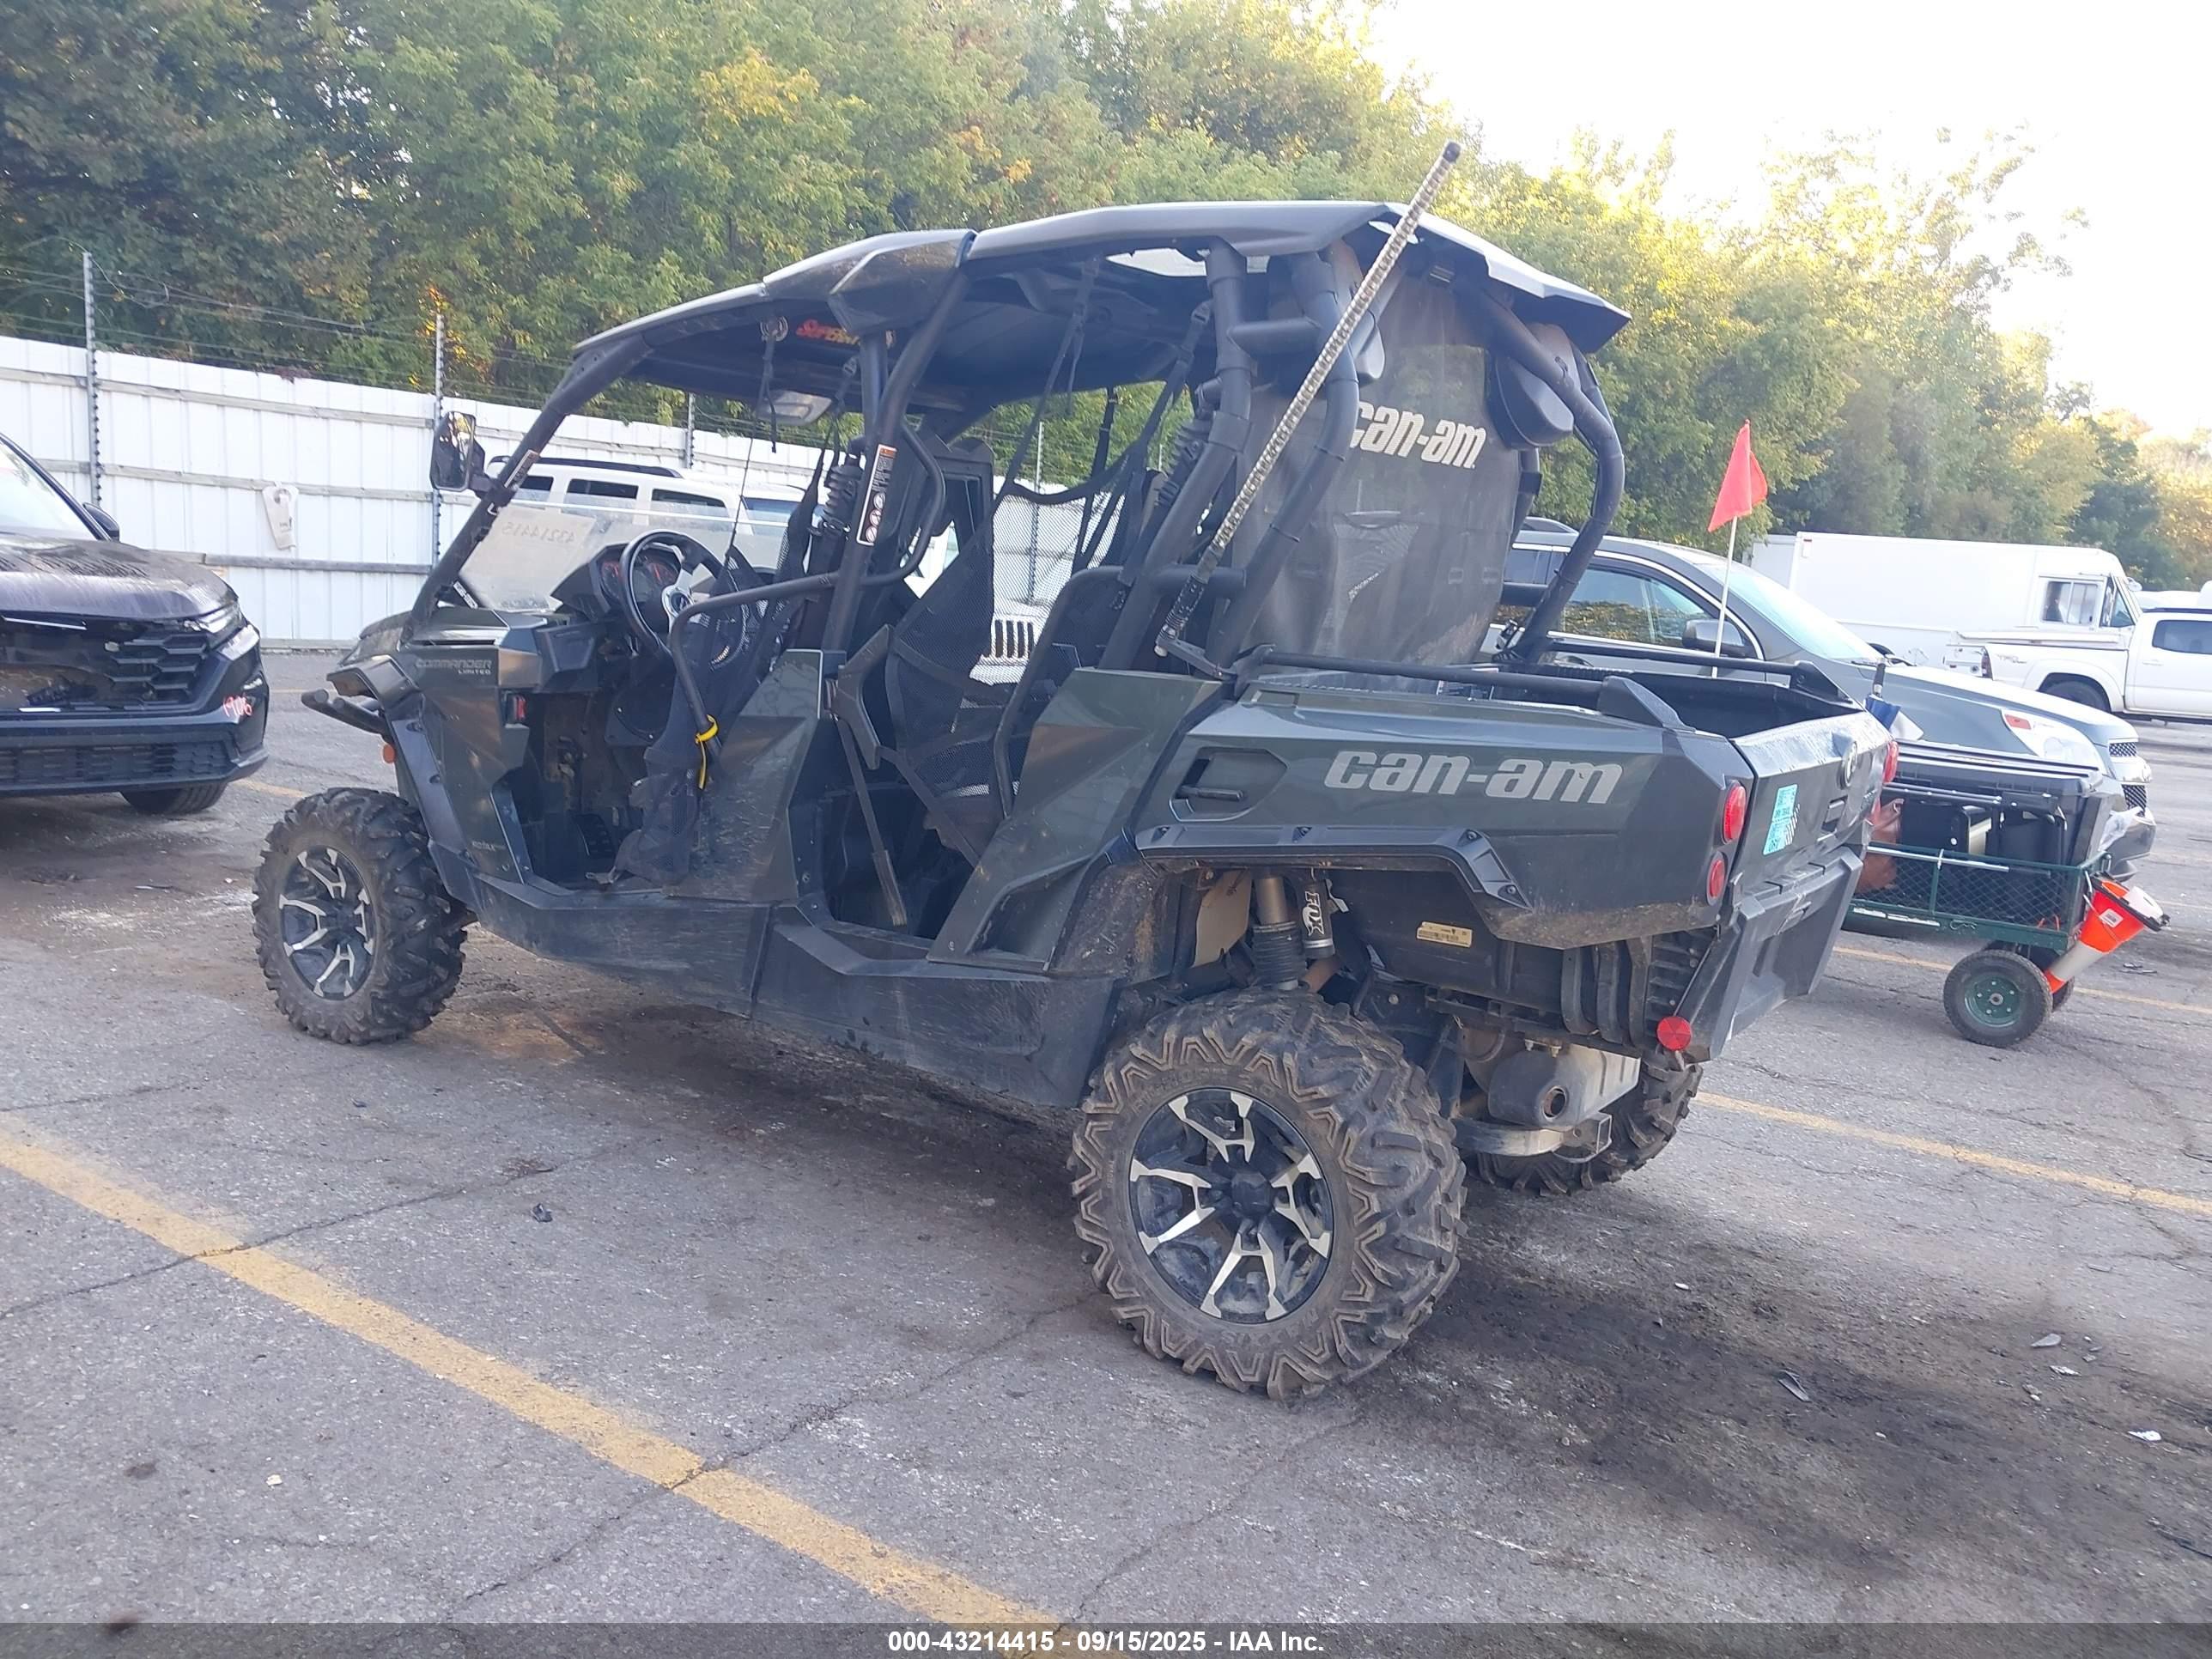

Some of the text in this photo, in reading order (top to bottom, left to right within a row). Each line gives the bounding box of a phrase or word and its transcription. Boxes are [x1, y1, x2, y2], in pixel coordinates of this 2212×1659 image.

[416, 659, 492, 669] COMMANDER
[1324, 750, 1623, 804] can-am
[1303, 891, 1325, 936] FOX
